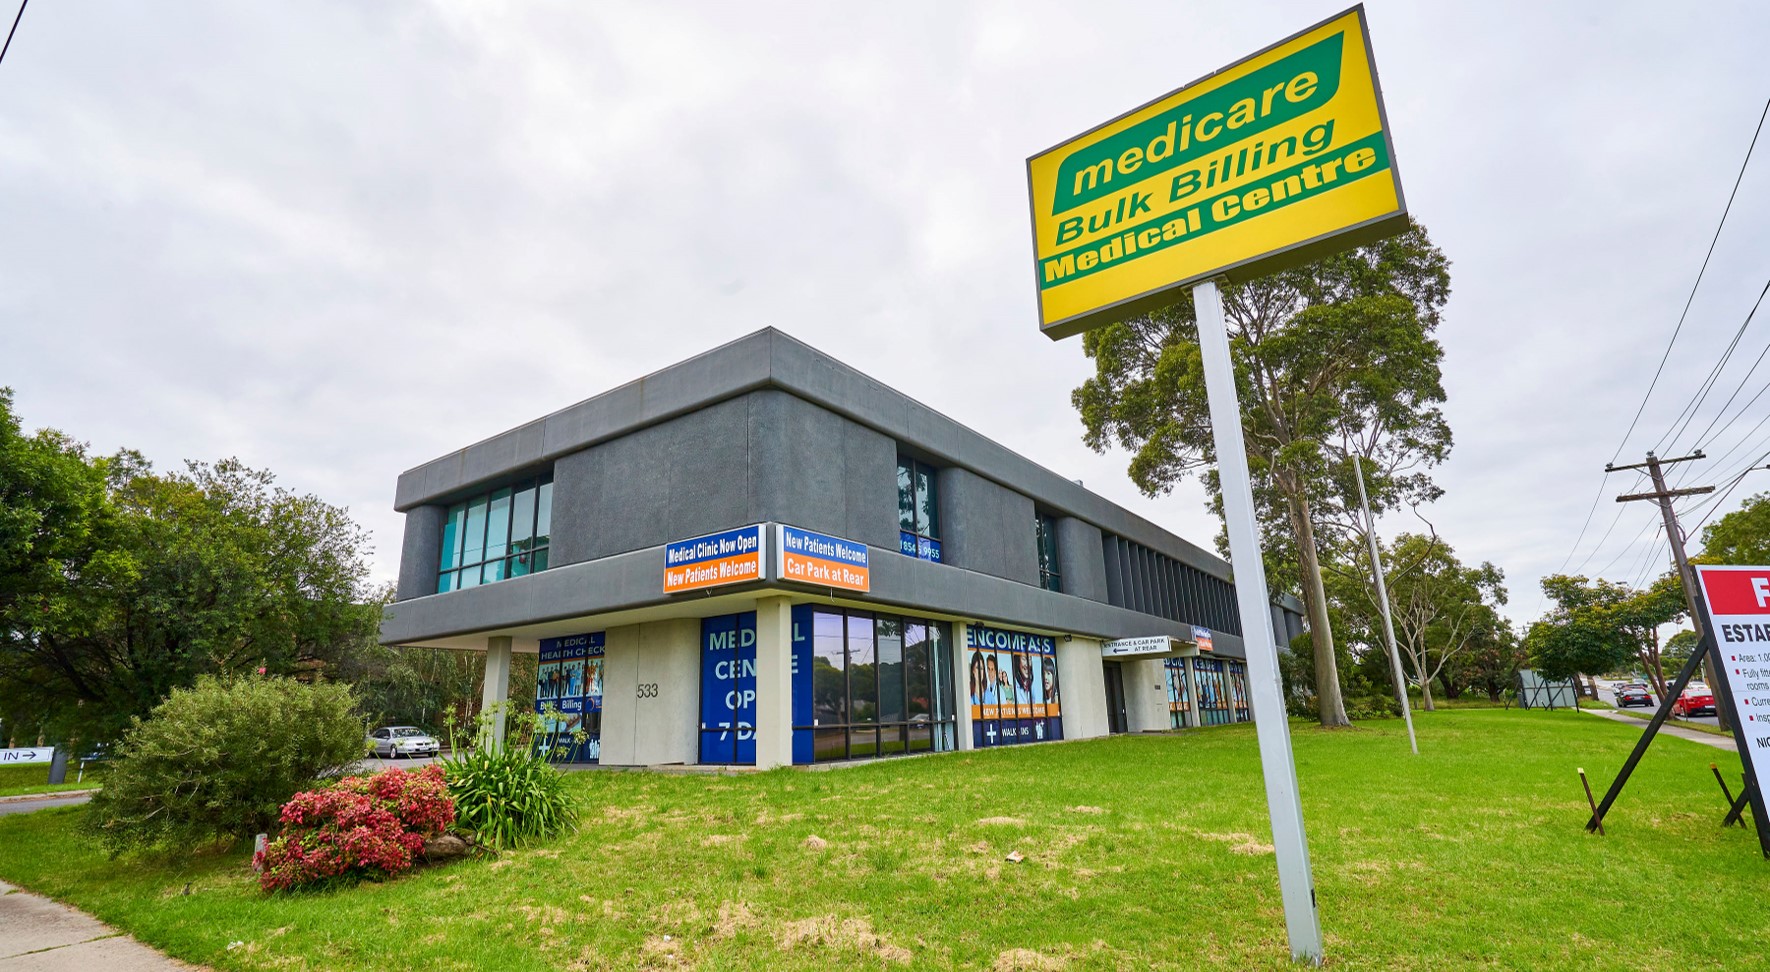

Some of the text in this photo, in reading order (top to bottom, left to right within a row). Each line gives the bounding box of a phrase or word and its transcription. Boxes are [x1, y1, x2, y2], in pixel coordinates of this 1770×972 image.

[1073, 71, 1318, 196] medicare
[1056, 119, 1335, 247] Bulk Billing
[1044, 147, 1377, 283] Medical Centre
[669, 535, 757, 564] Medical Clinic Now Open
[786, 532, 866, 563] New Patients Welcome
[668, 560, 756, 587] New Patients Welcome
[787, 558, 864, 586] Car Park at Rear
[1742, 668, 1759, 680] Fully
[1746, 682, 1769, 691] rooms
[637, 683, 659, 699] 533
[562, 700, 582, 711] Billing
[3, 752, 19, 760] IN
